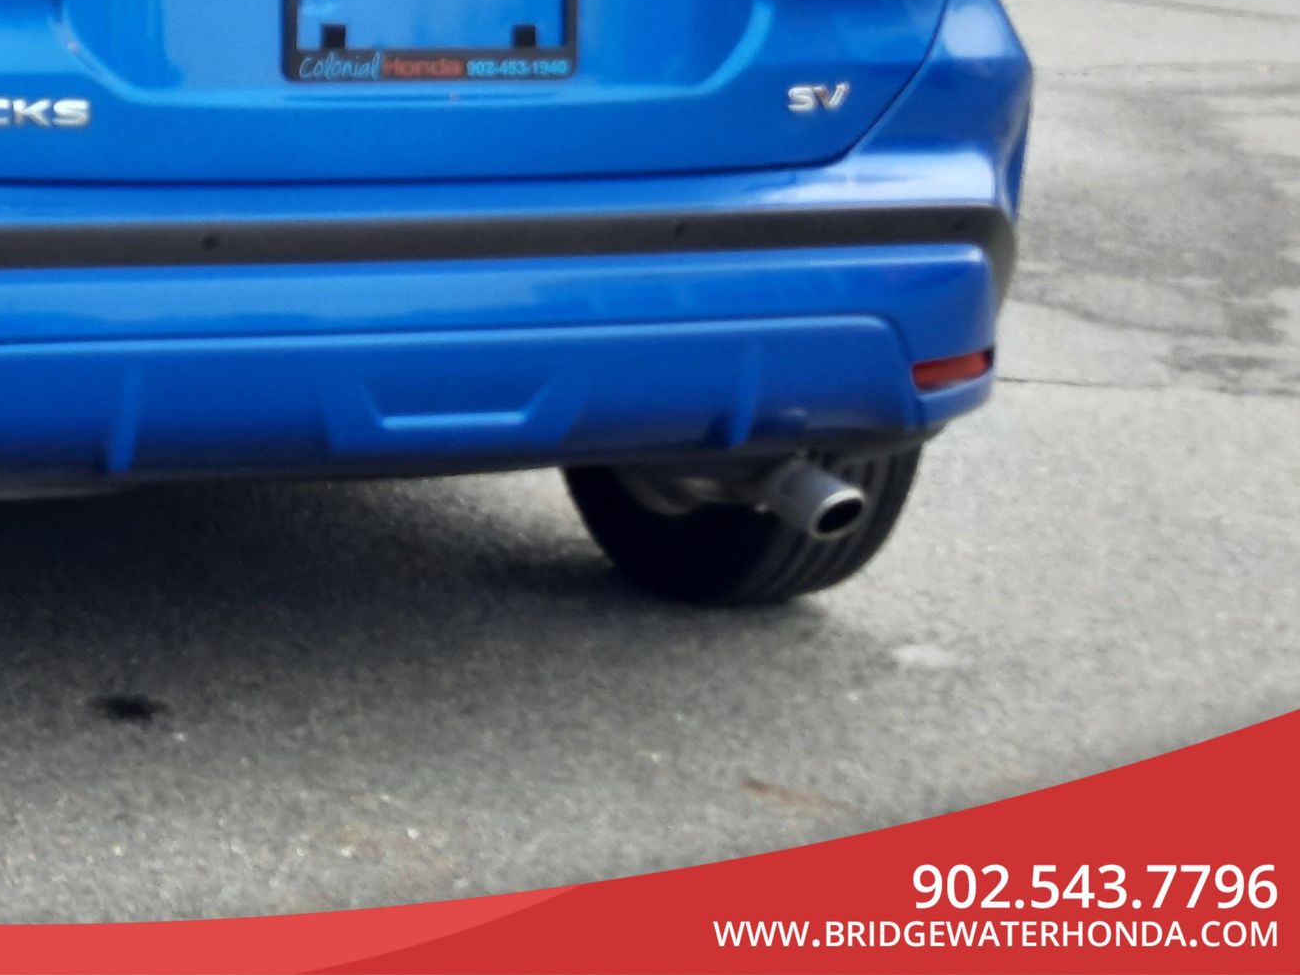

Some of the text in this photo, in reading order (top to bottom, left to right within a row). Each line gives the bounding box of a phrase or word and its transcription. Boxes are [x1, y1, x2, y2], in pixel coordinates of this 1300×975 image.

[299, 51, 380, 80] Colonial
[382, 56, 462, 76] Honda
[787, 82, 850, 112] SV
